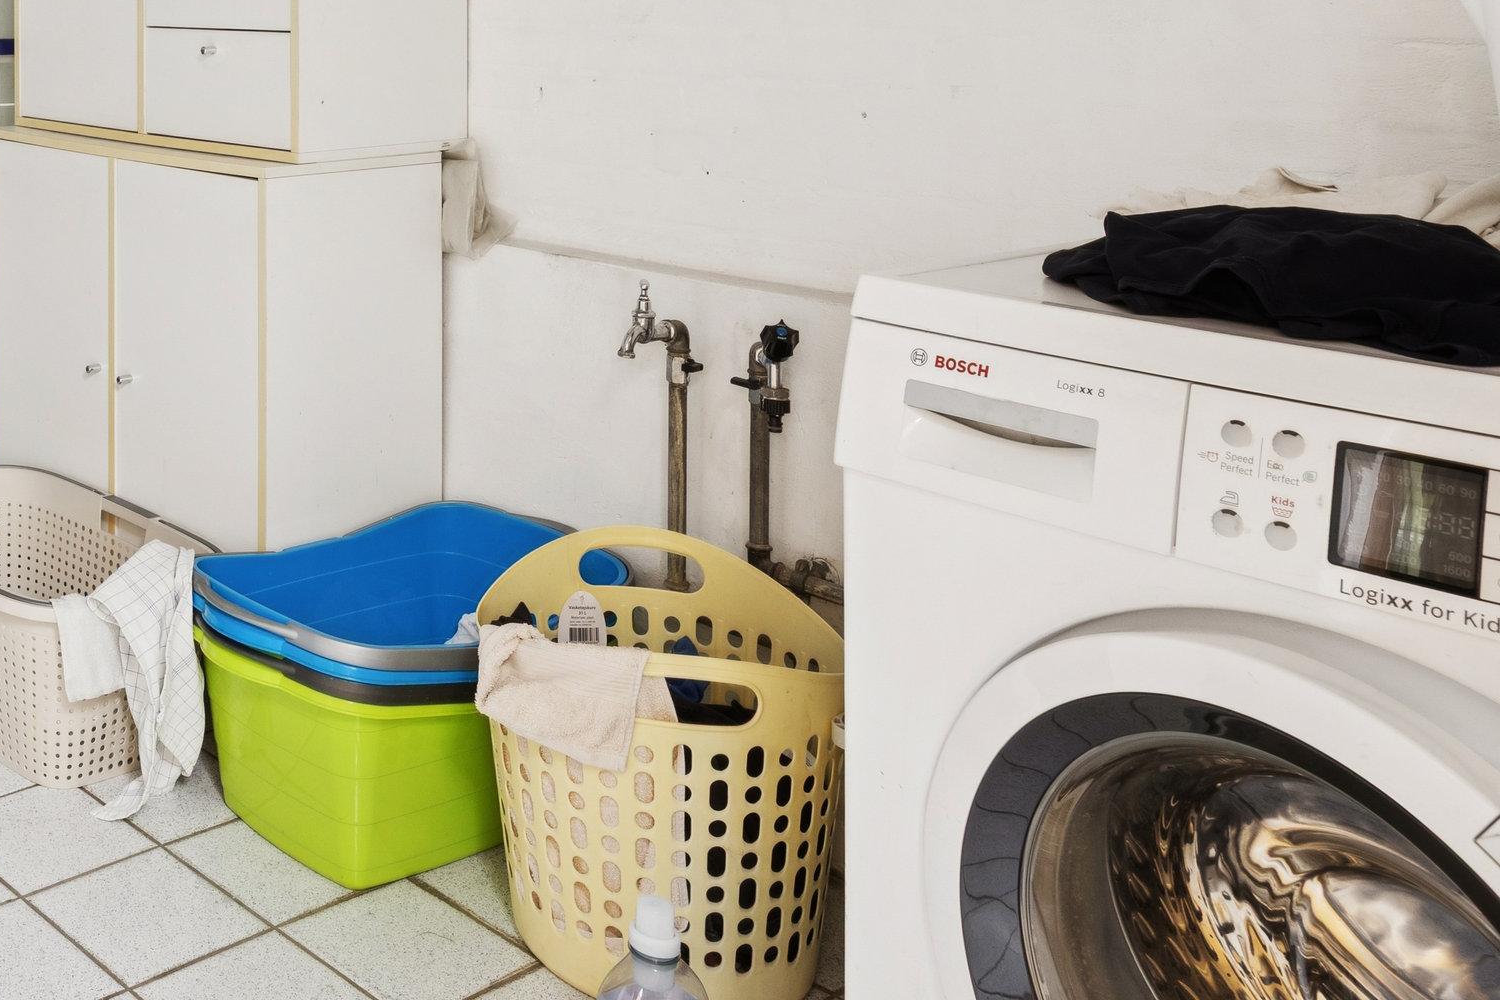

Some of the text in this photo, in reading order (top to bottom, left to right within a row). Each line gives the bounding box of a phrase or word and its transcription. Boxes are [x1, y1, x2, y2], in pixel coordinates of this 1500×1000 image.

[934, 354, 990, 378] BOSCH
[1056, 379, 1106, 398] Logixx 8
[1225, 451, 1255, 465] Speed
[1220, 462, 1253, 477] Perfect
[1265, 471, 1301, 487] Perfect
[1271, 495, 1296, 508] Kids
[1339, 578, 1413, 612] Logixx
[1422, 600, 1455, 621] for
